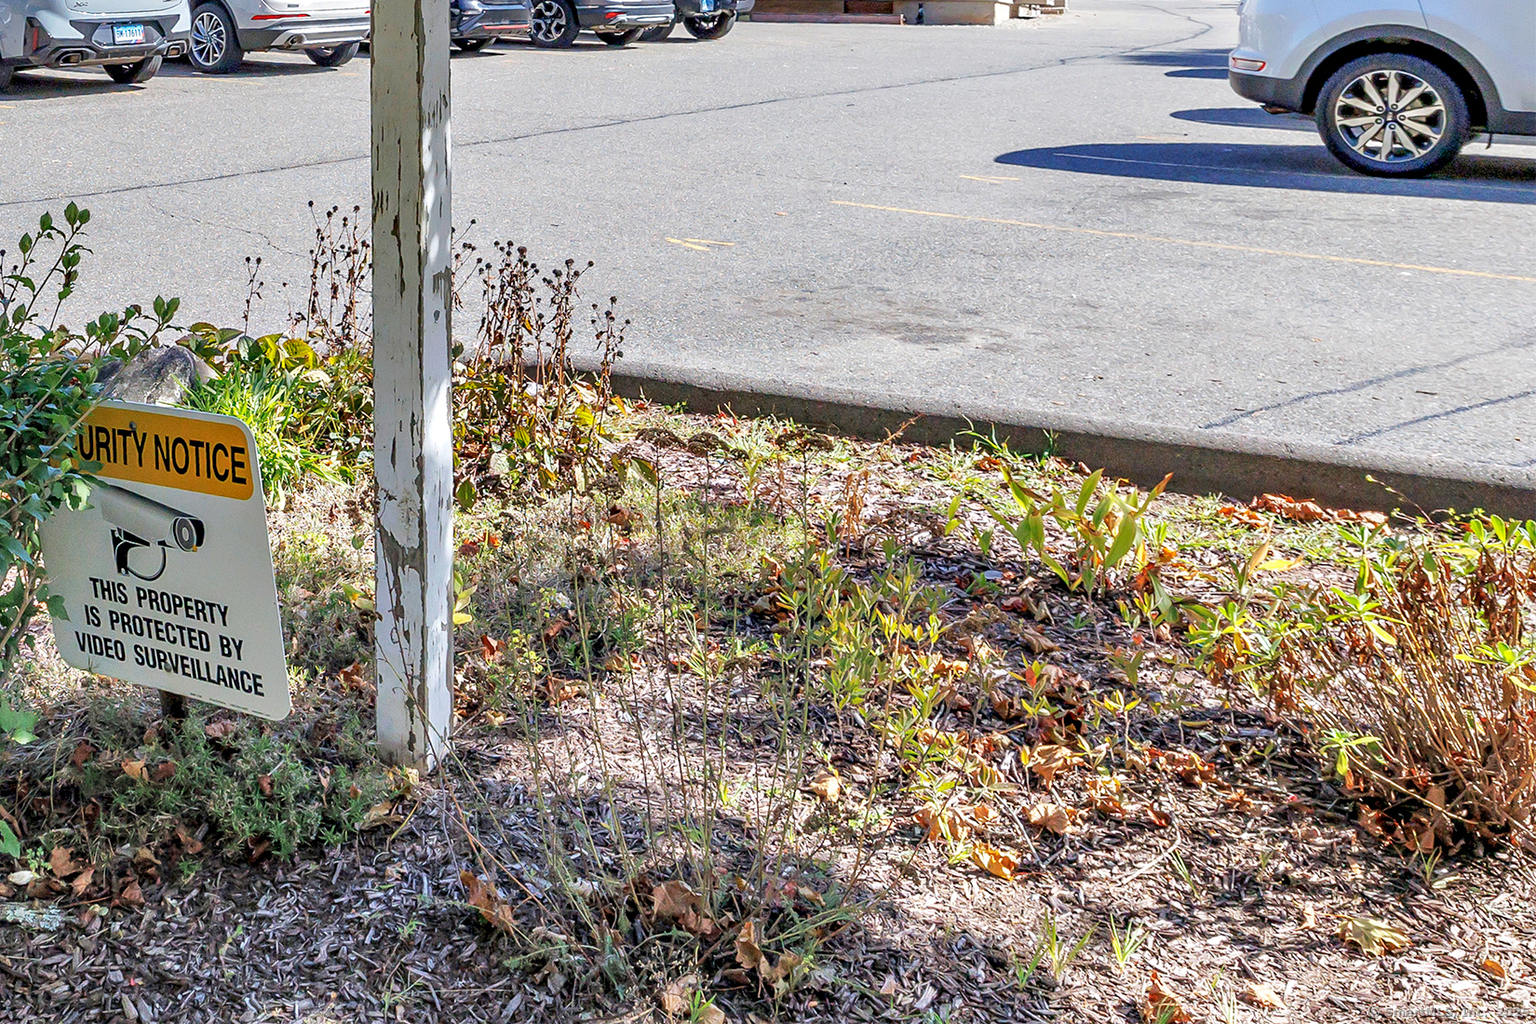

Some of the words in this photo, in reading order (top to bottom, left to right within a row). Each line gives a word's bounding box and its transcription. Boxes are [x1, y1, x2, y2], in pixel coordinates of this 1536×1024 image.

[67, 424, 147, 467] URITY
[154, 434, 247, 485] NOTICE
[89, 576, 128, 605] THIS
[137, 586, 228, 626] PROPERTY
[84, 604, 101, 626] IS
[108, 610, 211, 653] PROTECTED
[219, 636, 243, 661] BY
[74, 631, 126, 662] VIDEO
[133, 643, 265, 697] SURVEILLANCE
